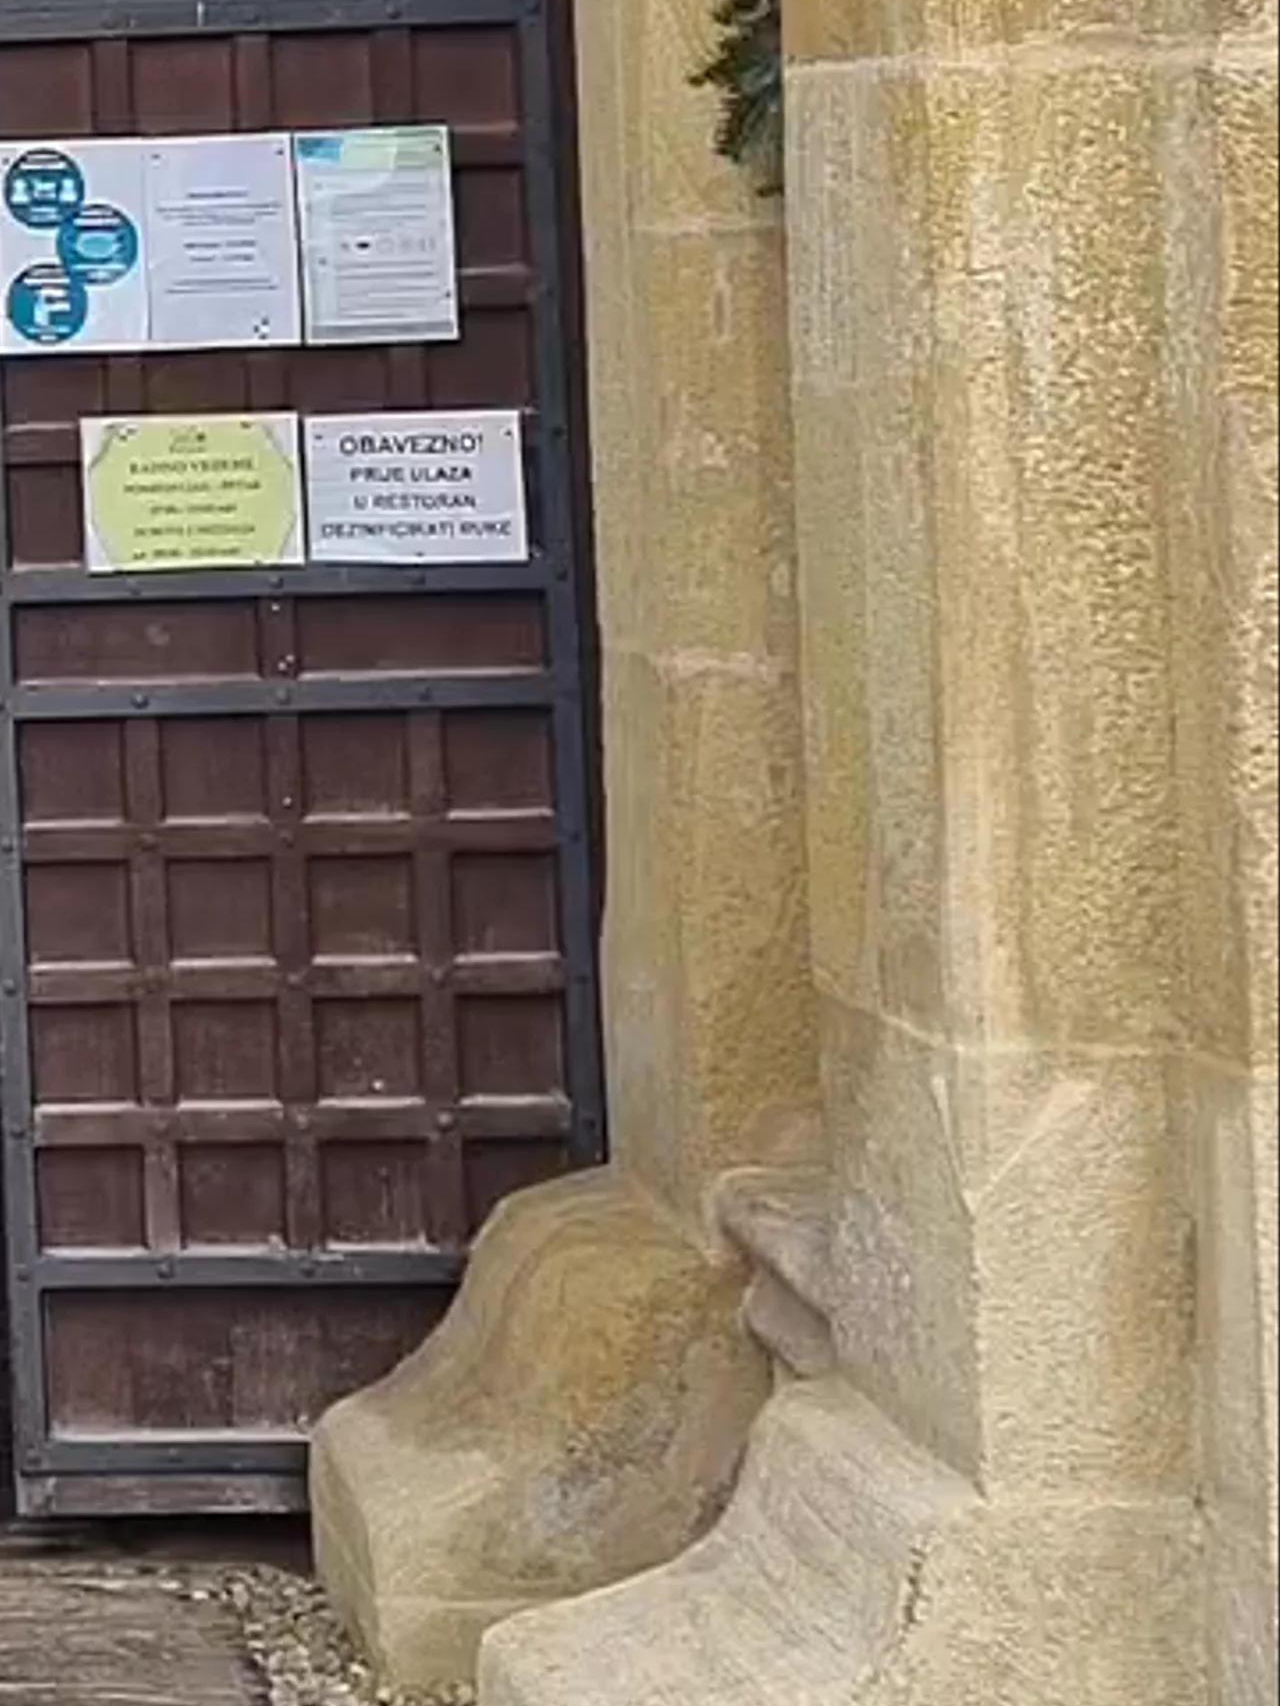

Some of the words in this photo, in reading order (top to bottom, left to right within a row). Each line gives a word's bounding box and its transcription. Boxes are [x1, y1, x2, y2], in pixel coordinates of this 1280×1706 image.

[340, 434, 483, 455] OBAVEZNO!
[350, 466, 405, 482] PRIJE
[410, 466, 472, 482] ULAZA
[353, 495, 368, 510] U
[372, 494, 476, 510] RESTORAN
